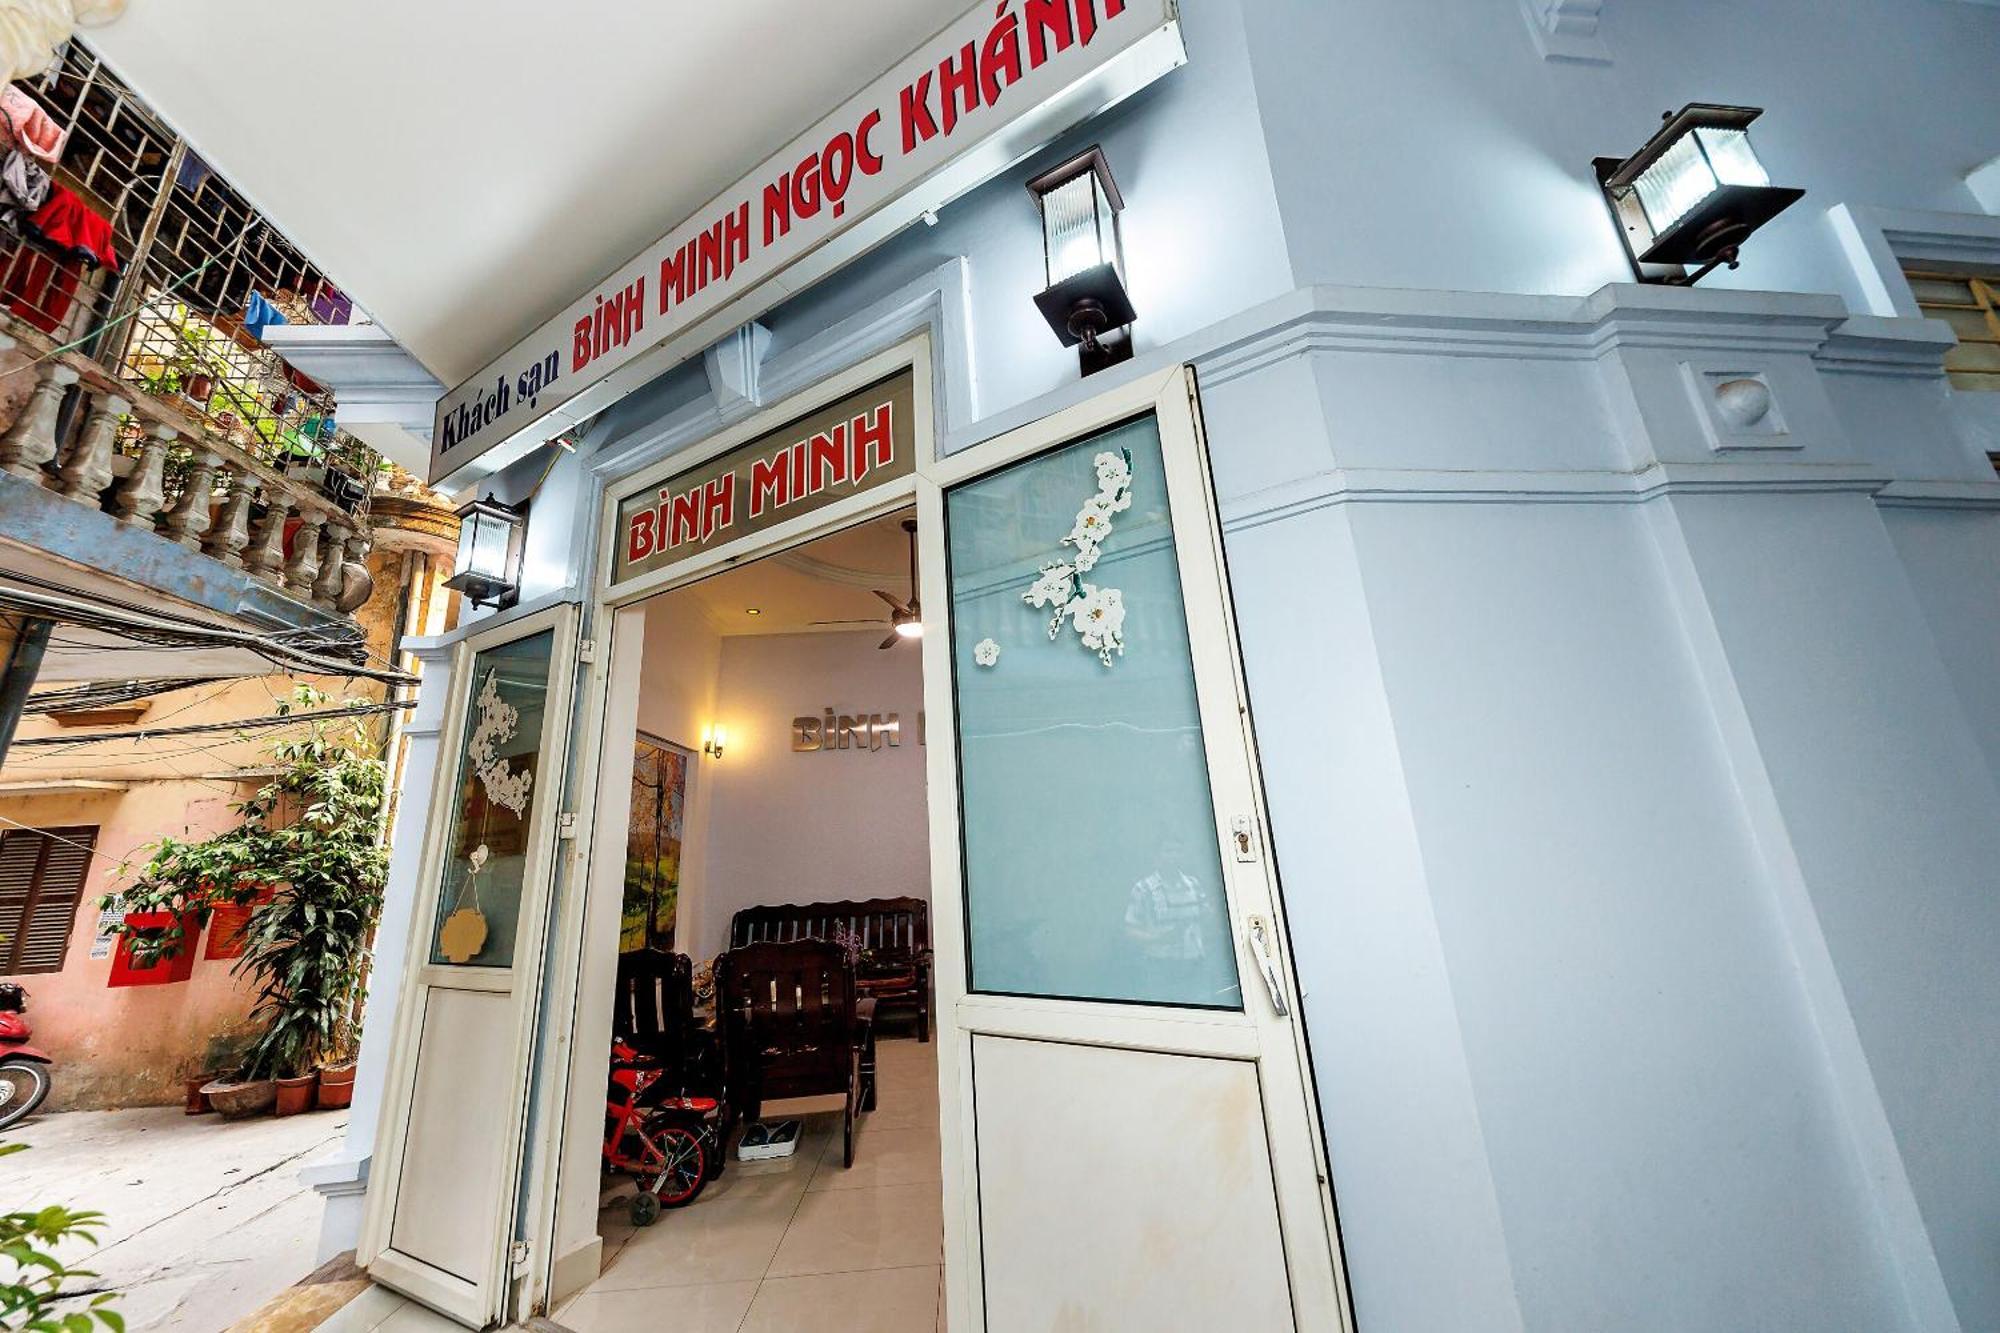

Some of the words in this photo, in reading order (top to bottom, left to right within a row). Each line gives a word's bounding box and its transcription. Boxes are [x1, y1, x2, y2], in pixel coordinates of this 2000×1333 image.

[440, 374, 510, 454] Khách
[516, 350, 559, 409] sạn
[660, 201, 749, 315] MINH
[763, 108, 883, 247] NGỌC
[749, 401, 894, 519] MINH
